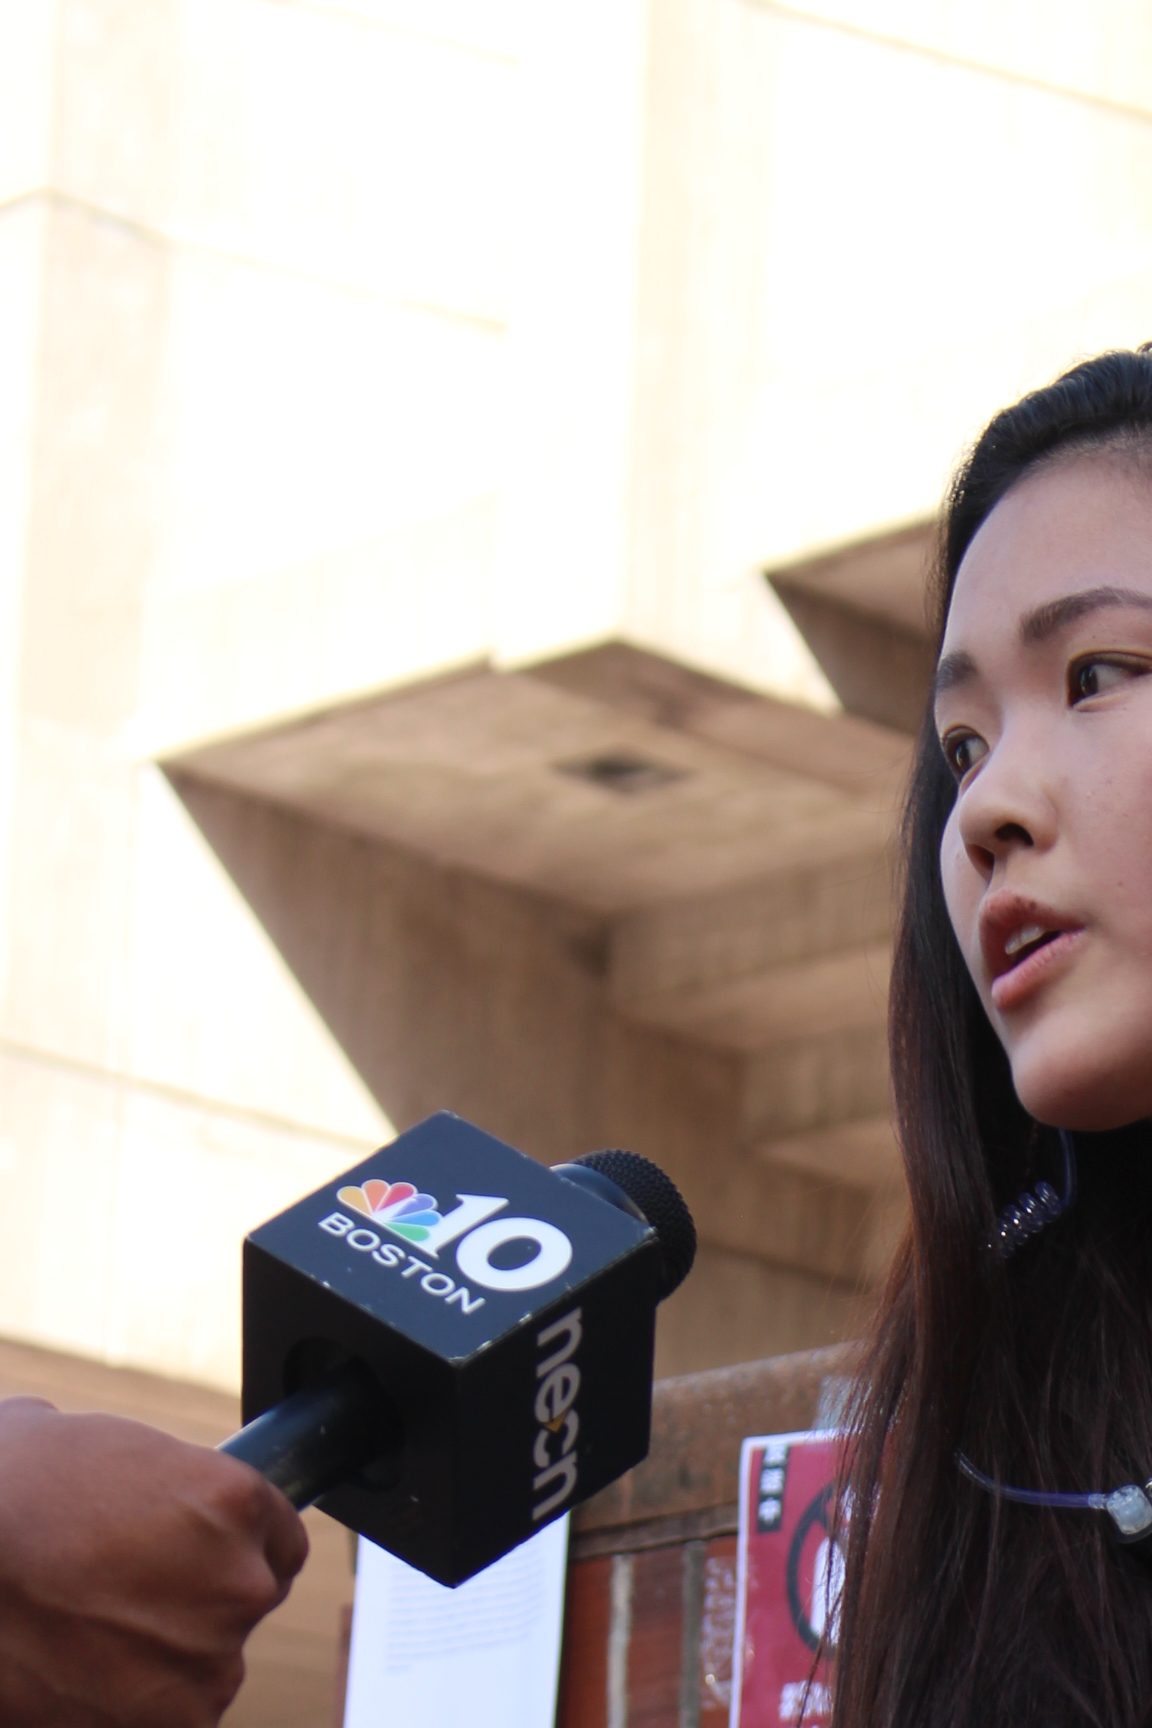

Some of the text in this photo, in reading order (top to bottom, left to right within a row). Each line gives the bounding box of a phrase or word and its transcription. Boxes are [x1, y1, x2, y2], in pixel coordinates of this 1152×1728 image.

[317, 1211, 486, 1314] BOSTON
[430, 1193, 573, 1292] 10
[531, 1305, 583, 1521] necn
